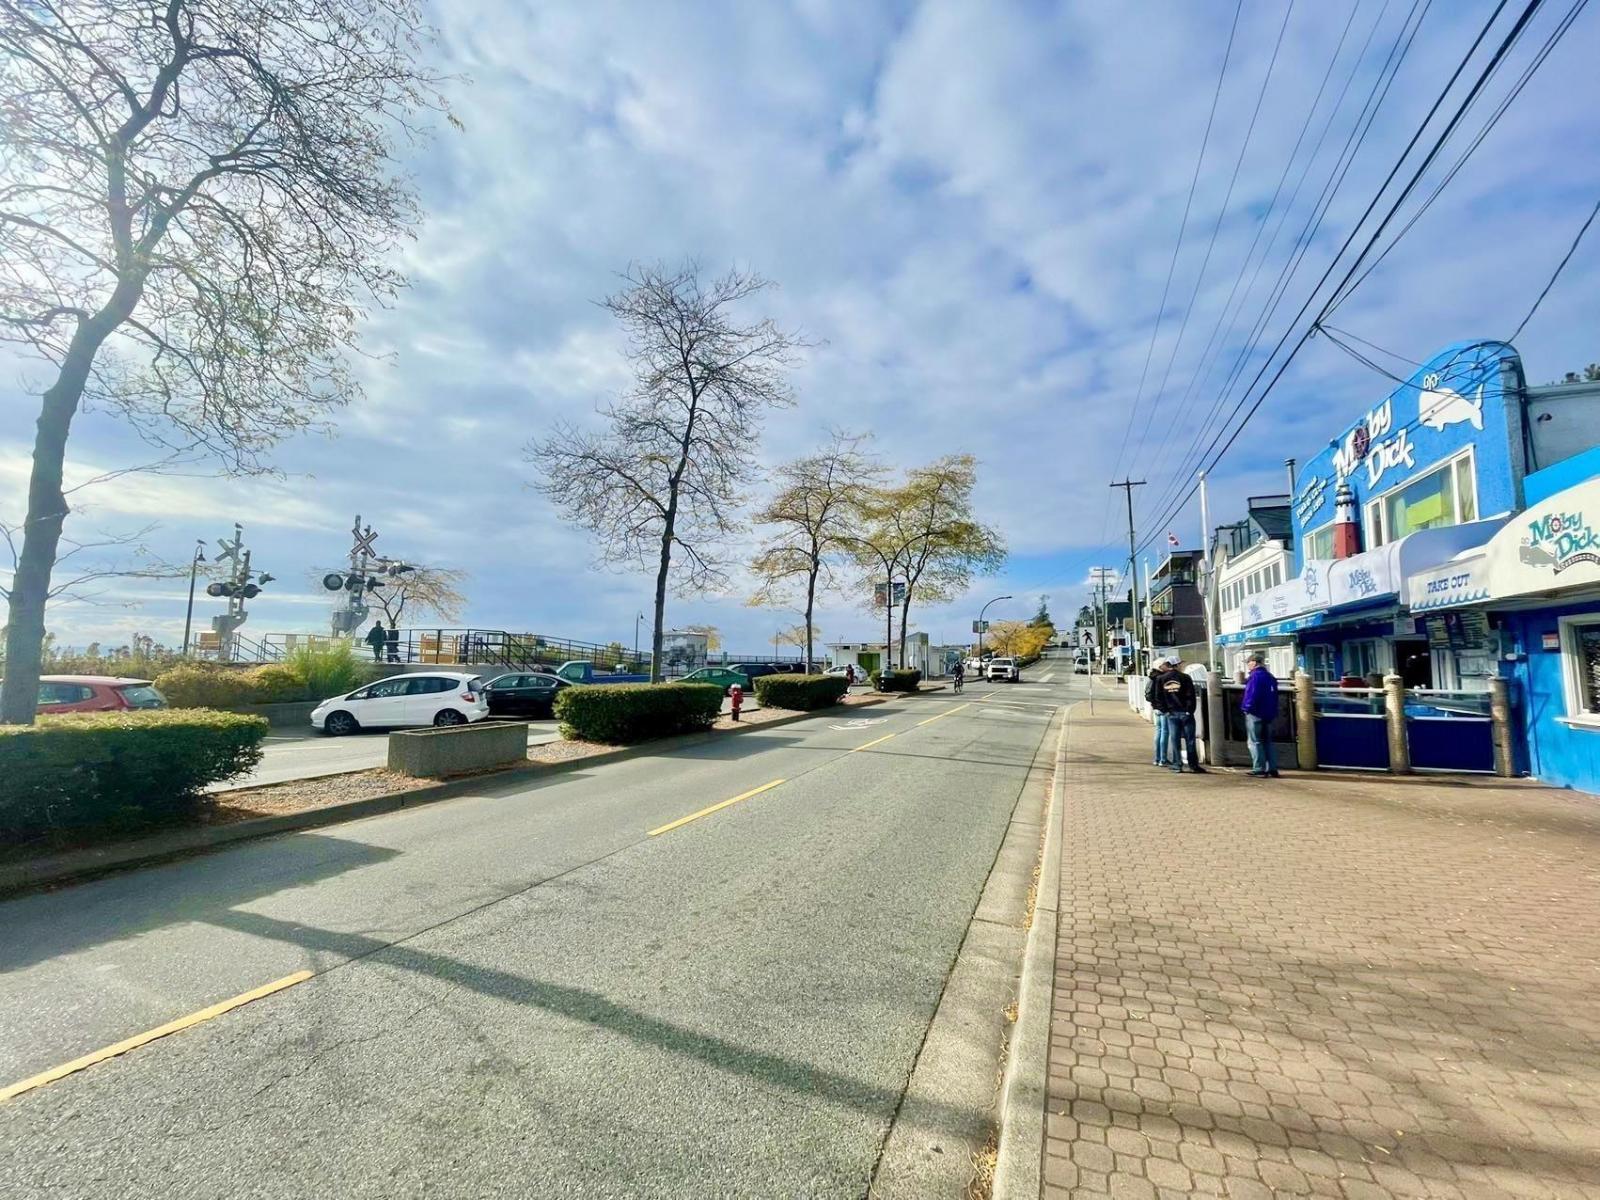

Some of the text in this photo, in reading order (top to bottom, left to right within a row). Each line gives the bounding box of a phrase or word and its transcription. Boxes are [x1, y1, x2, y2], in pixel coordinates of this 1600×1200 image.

[1332, 399, 1391, 476] Moby
[1365, 429, 1414, 489] Dick
[1528, 511, 1582, 546] Moby
[1555, 526, 1600, 560] Dick
[1427, 573, 1470, 593] TAKE OUT
